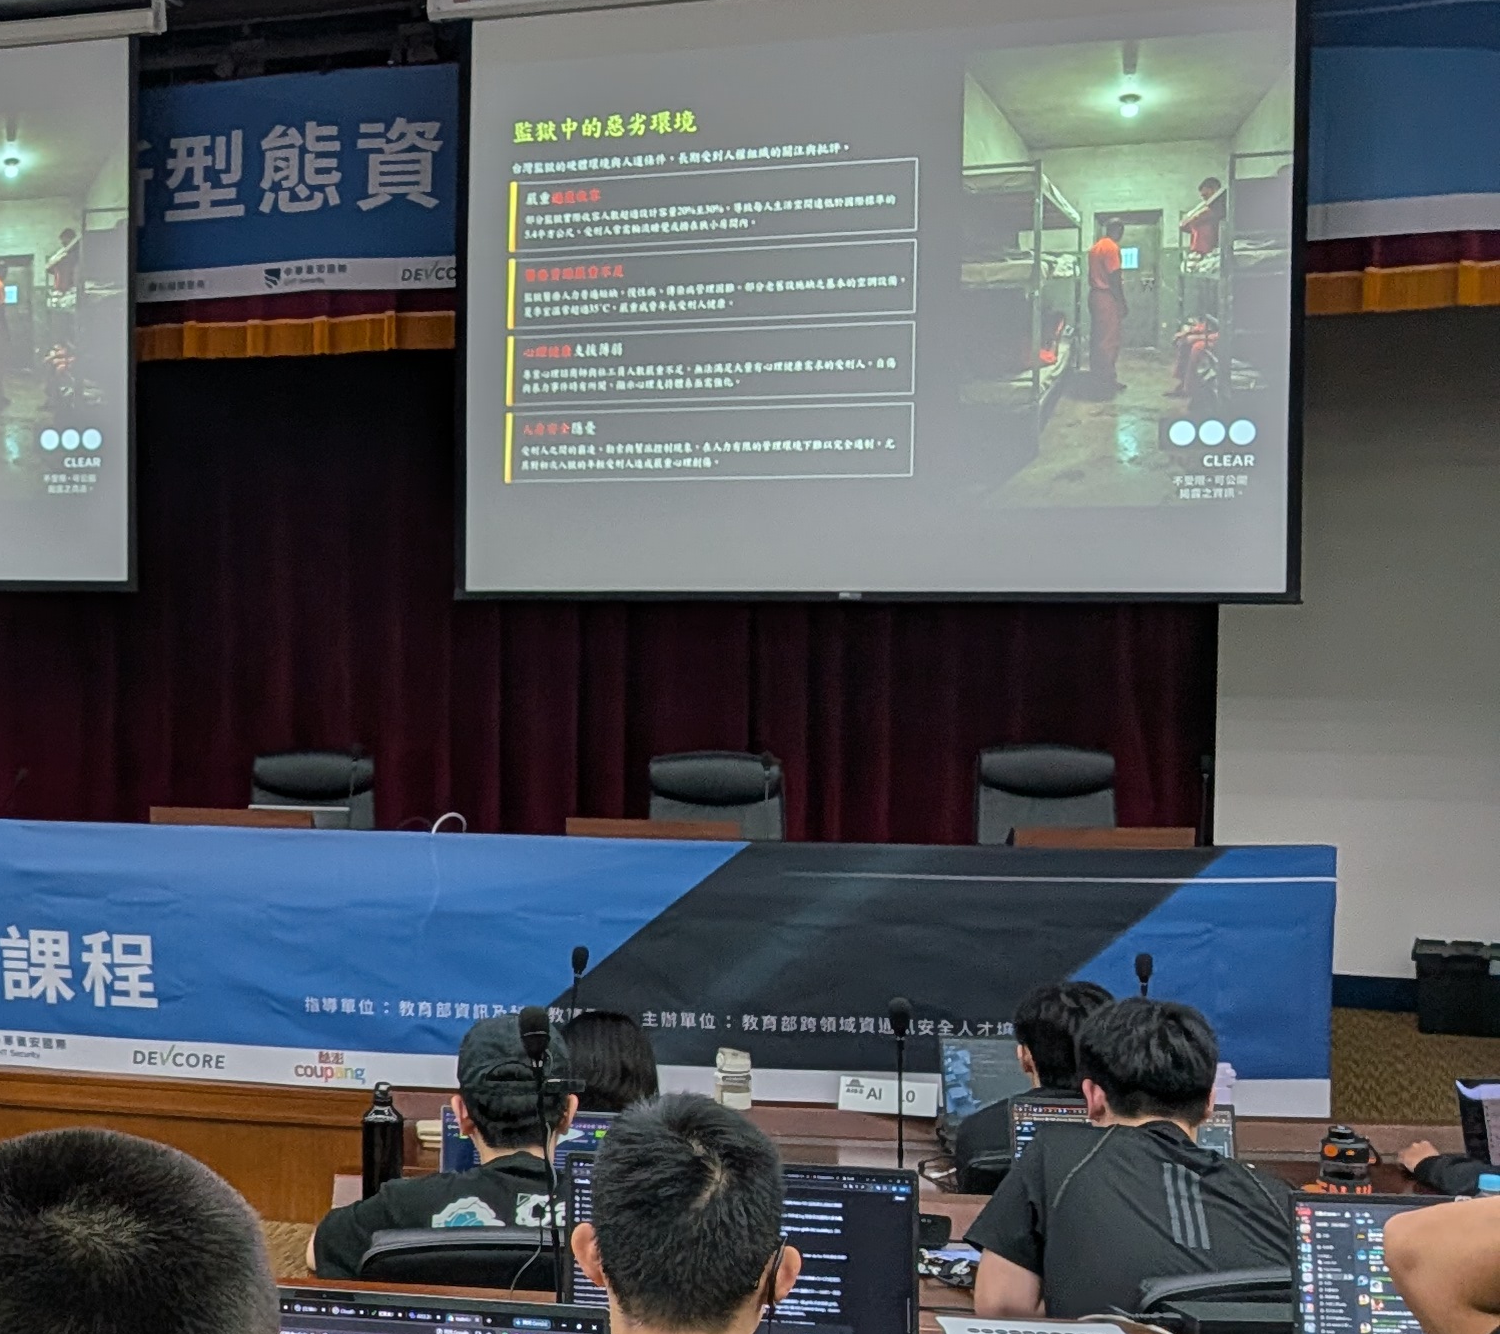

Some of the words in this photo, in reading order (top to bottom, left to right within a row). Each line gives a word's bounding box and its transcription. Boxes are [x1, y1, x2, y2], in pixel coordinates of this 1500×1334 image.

[513, 110, 698, 144] 監獄中的惡劣環境
[63, 457, 102, 468] CLEAR
[1202, 454, 1255, 468] CLEAR
[132, 1044, 226, 1070] DEVCORE
[294, 1064, 366, 1084] coupang
